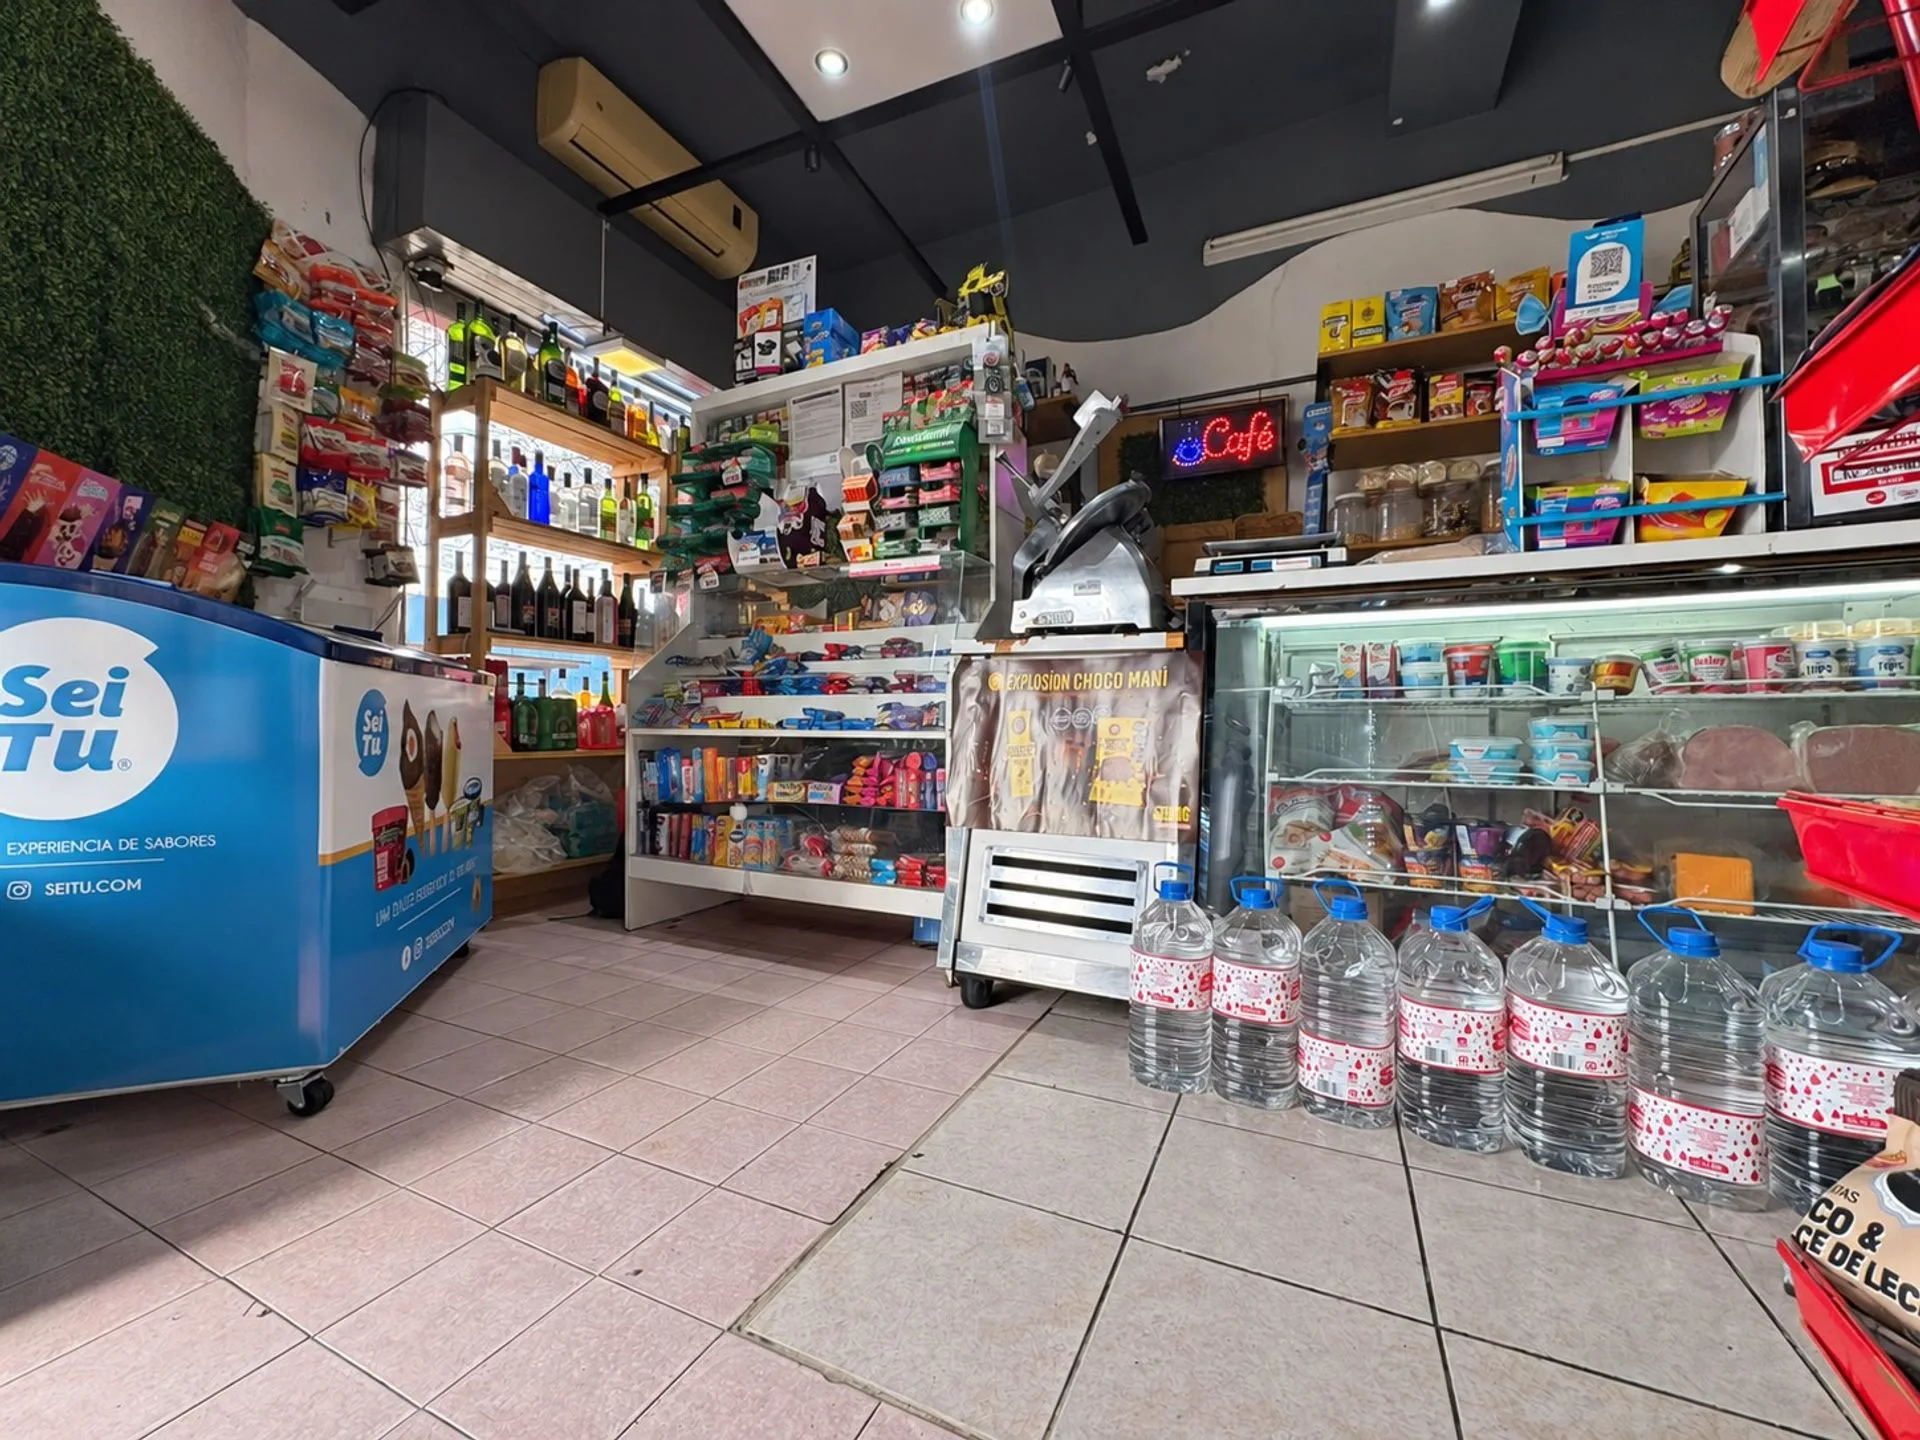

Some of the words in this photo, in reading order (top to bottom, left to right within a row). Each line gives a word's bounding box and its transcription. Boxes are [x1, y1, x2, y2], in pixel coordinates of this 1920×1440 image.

[1202, 410, 1275, 461] Café
[0, 664, 130, 718] Sei
[1073, 672, 1123, 690] CHOCO
[1128, 665, 1168, 688] MANÍ
[362, 709, 384, 733] Sei
[0, 722, 118, 773] Tu
[362, 735, 383, 757] Tu
[6, 838, 114, 856] EXPERIENCIA
[118, 837, 139, 851] DE
[144, 834, 217, 850] SABORES
[44, 878, 142, 897] SEITU.COM
[1808, 1197, 1855, 1236] CO
[1857, 1221, 1885, 1253] &
[1827, 1241, 1866, 1277] DE
[1863, 1260, 1920, 1317] LEC
